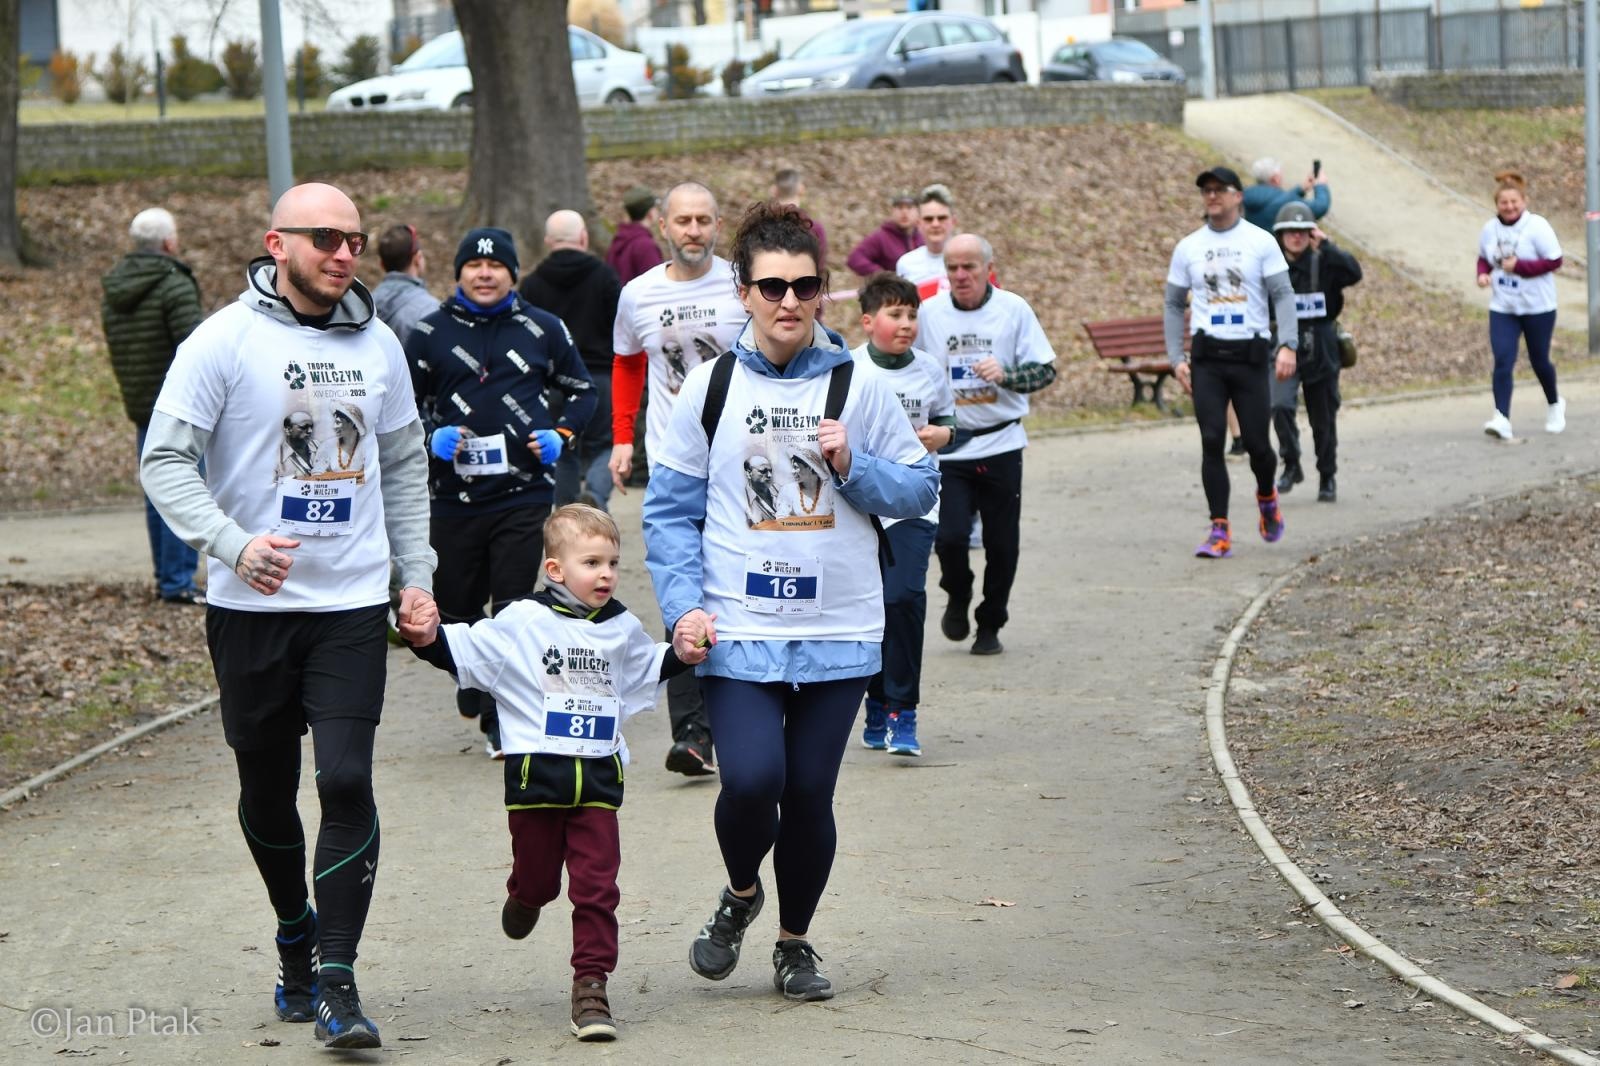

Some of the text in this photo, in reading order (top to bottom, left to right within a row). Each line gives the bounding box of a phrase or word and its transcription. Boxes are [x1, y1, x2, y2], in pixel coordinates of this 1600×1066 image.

[677, 308, 716, 320] WILCZYM
[307, 362, 335, 370] TROPEM
[309, 370, 364, 383] WILCZYM
[313, 388, 367, 398] XIV EDYCJA 2026
[901, 399, 921, 408] CZYM
[771, 407, 798, 415] TROPEM
[783, 434, 806, 443] EDYCJA
[807, 434, 819, 442] 202
[469, 450, 488, 465] 31
[314, 488, 339, 496] WILCZYM
[305, 500, 336, 522] 82
[774, 566, 801, 574] WILCZYM
[769, 577, 798, 598] 16
[567, 647, 595, 657] TROPEM
[568, 676, 579, 685] XIV
[580, 676, 604, 685] EDYCJA
[577, 704, 603, 712] WILCZYM
[569, 715, 597, 738] 81
